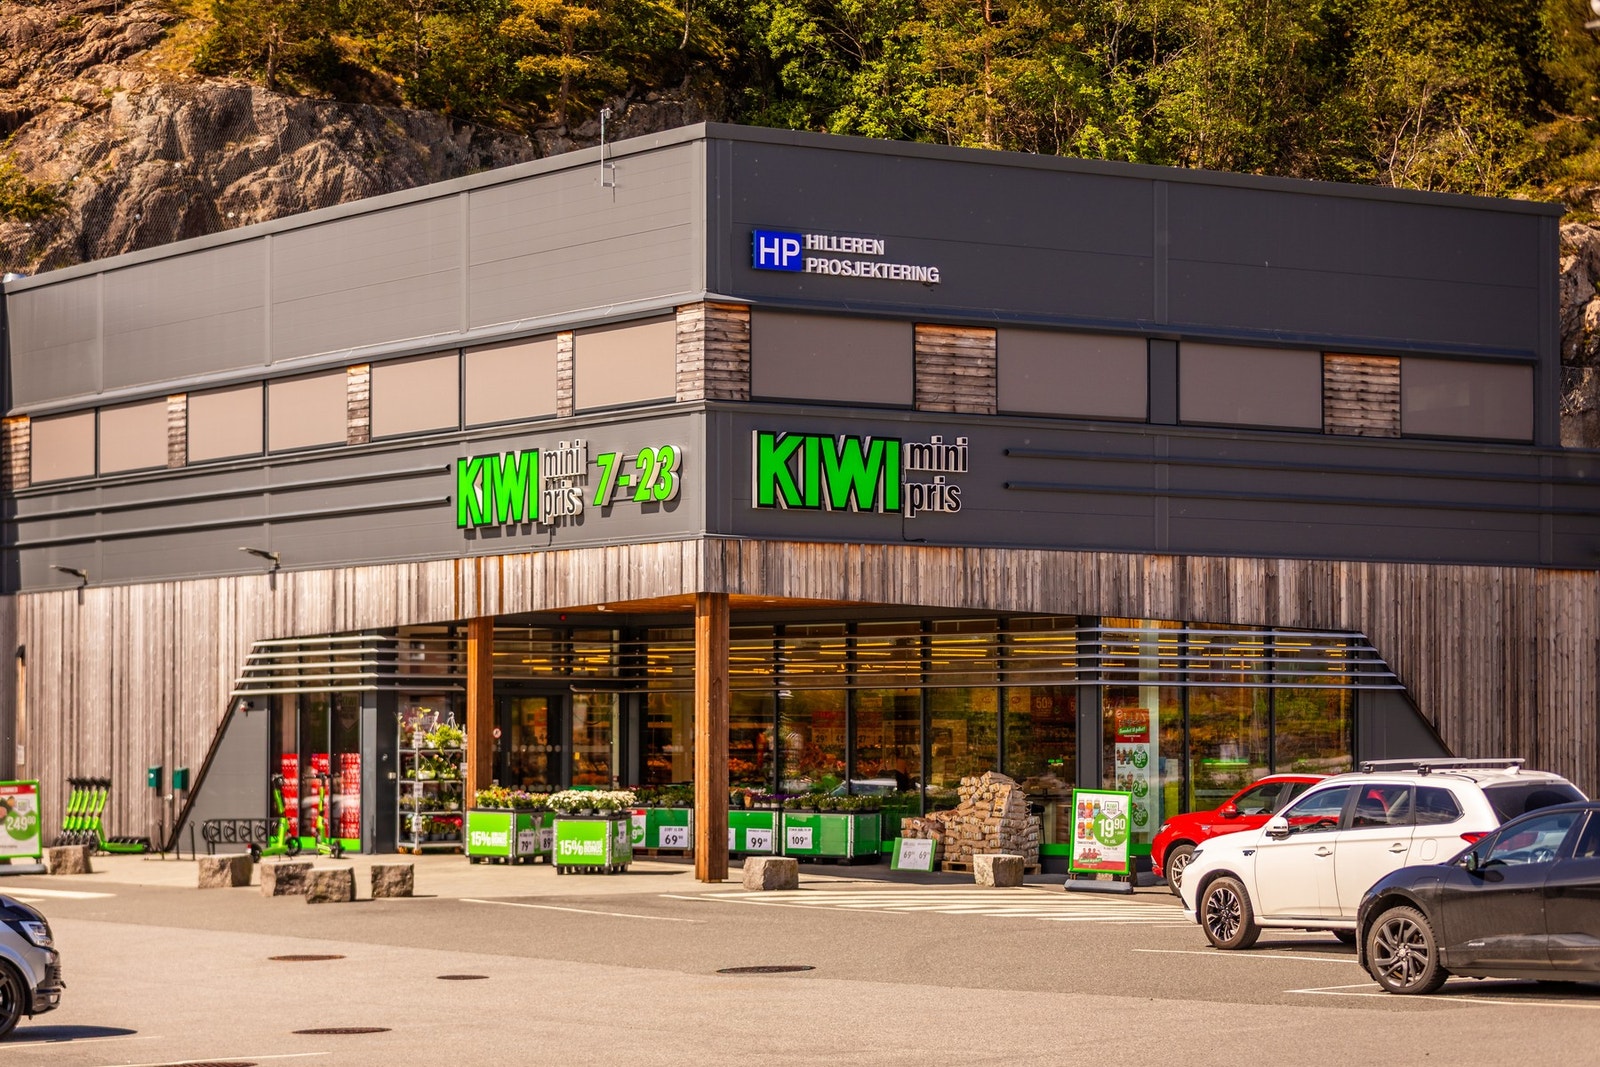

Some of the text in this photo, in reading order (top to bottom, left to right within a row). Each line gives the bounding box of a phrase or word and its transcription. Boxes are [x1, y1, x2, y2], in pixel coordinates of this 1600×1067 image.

[759, 236, 800, 267] HP
[805, 233, 885, 255] HILLEREN
[805, 257, 941, 283] PROSJEKTERING
[543, 439, 587, 478] mini
[903, 435, 968, 473] mini
[593, 445, 681, 507] 7-23
[752, 430, 902, 514] KIWI
[456, 447, 544, 529] KIWI
[903, 475, 962, 518] pris
[542, 479, 583, 526] pris
[6, 815, 28, 832] 249
[1098, 818, 1126, 838] 19 90
[470, 831, 492, 847] 15%
[521, 840, 529, 852] 79
[559, 838, 584, 857] 15%
[665, 834, 678, 845] 69
[751, 837, 763, 848] 99
[792, 836, 804, 846] 109
